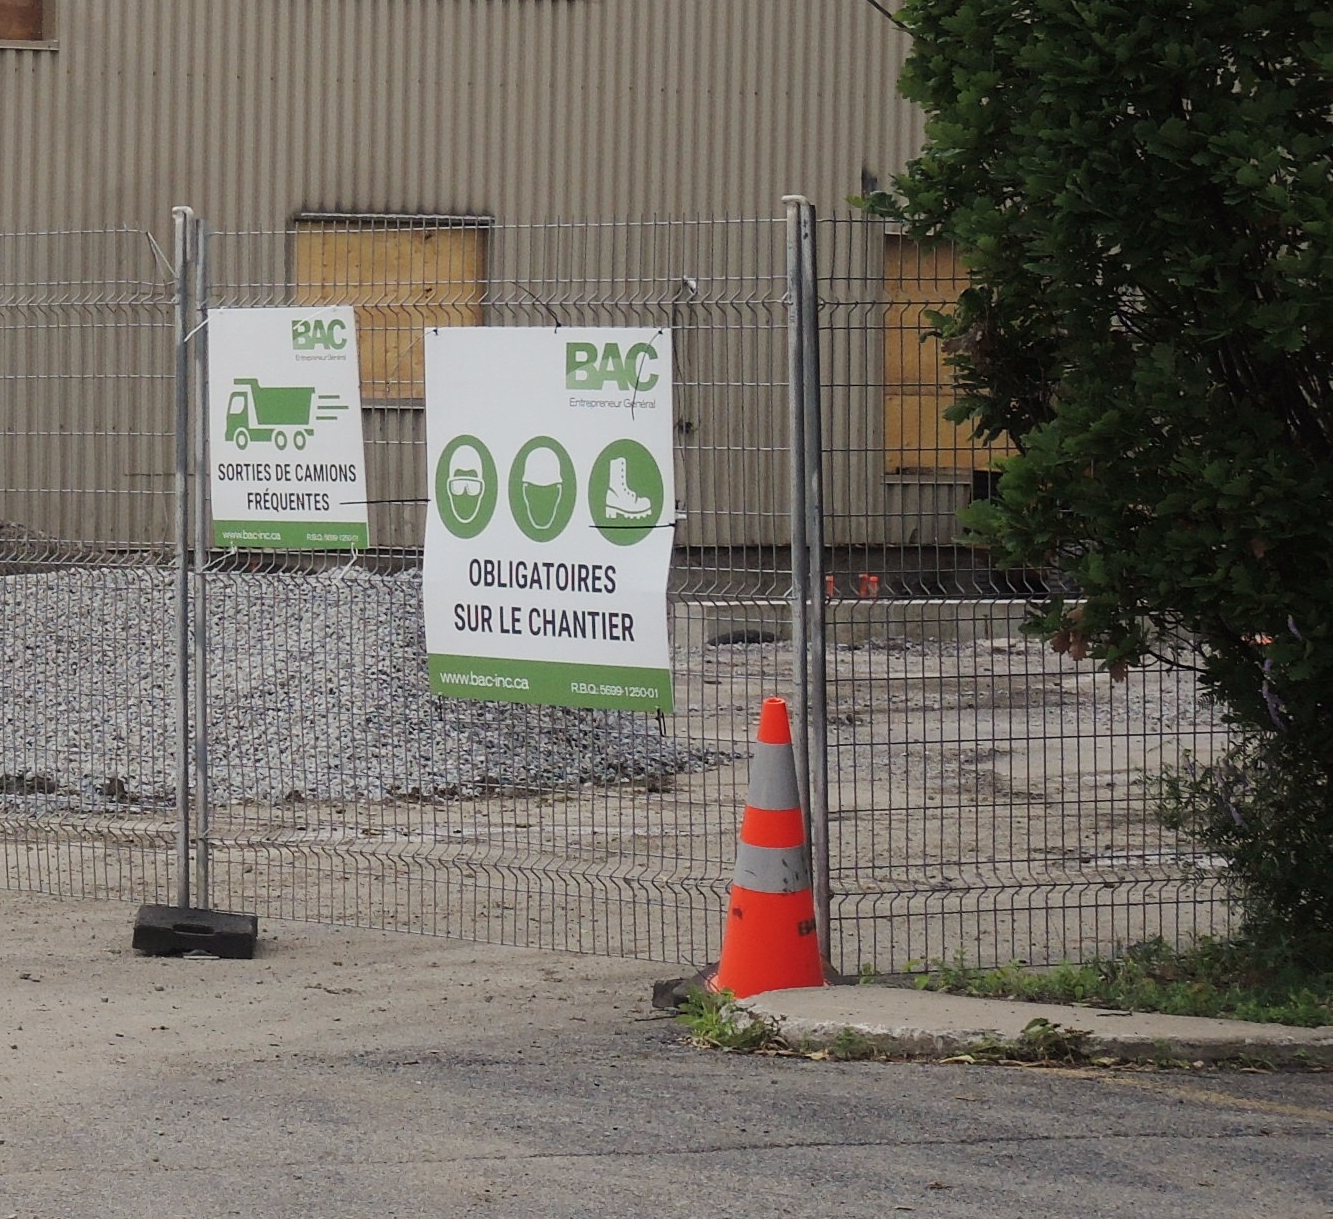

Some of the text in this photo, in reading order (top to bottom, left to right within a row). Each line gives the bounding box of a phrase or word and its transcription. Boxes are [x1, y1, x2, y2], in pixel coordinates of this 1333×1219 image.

[292, 319, 347, 350] BAC
[565, 342, 660, 392] BAC
[569, 397, 623, 408] Entrepreneur
[218, 463, 357, 483] SORTIES DE CAMIONS
[247, 488, 330, 512] FRÉQUENTES
[469, 558, 617, 594] OBLIGATOIRES
[453, 603, 635, 642] SUR LE CHANTIER
[440, 671, 530, 690] www.bac-inc.ca
